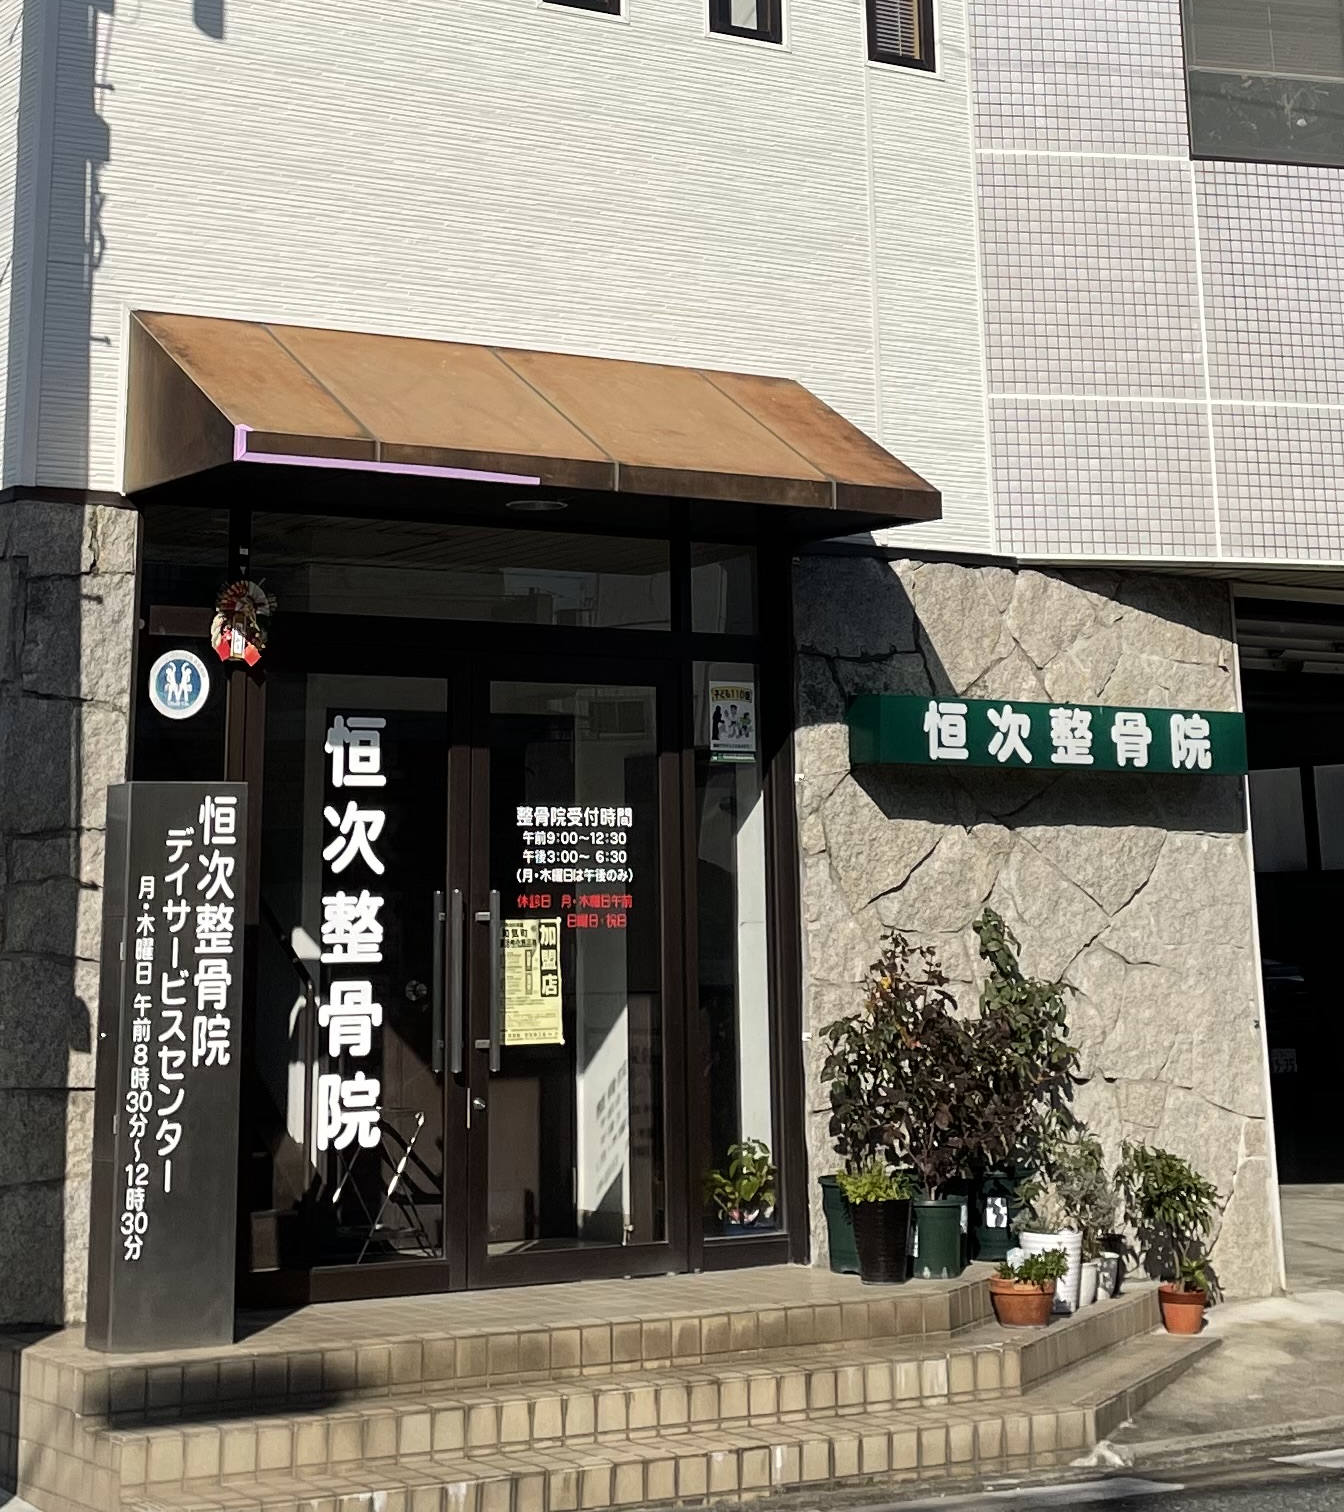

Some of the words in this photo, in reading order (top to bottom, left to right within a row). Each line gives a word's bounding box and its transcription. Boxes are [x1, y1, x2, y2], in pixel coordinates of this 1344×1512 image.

[516, 806, 634, 827] 整骨院受付時間
[923, 700, 1212, 770] 恒次整骨院
[155, 826, 195, 1194] デイサービスセンター
[192, 795, 238, 1068] 恒次整骨院
[317, 714, 387, 1152] 恒次整骨院
